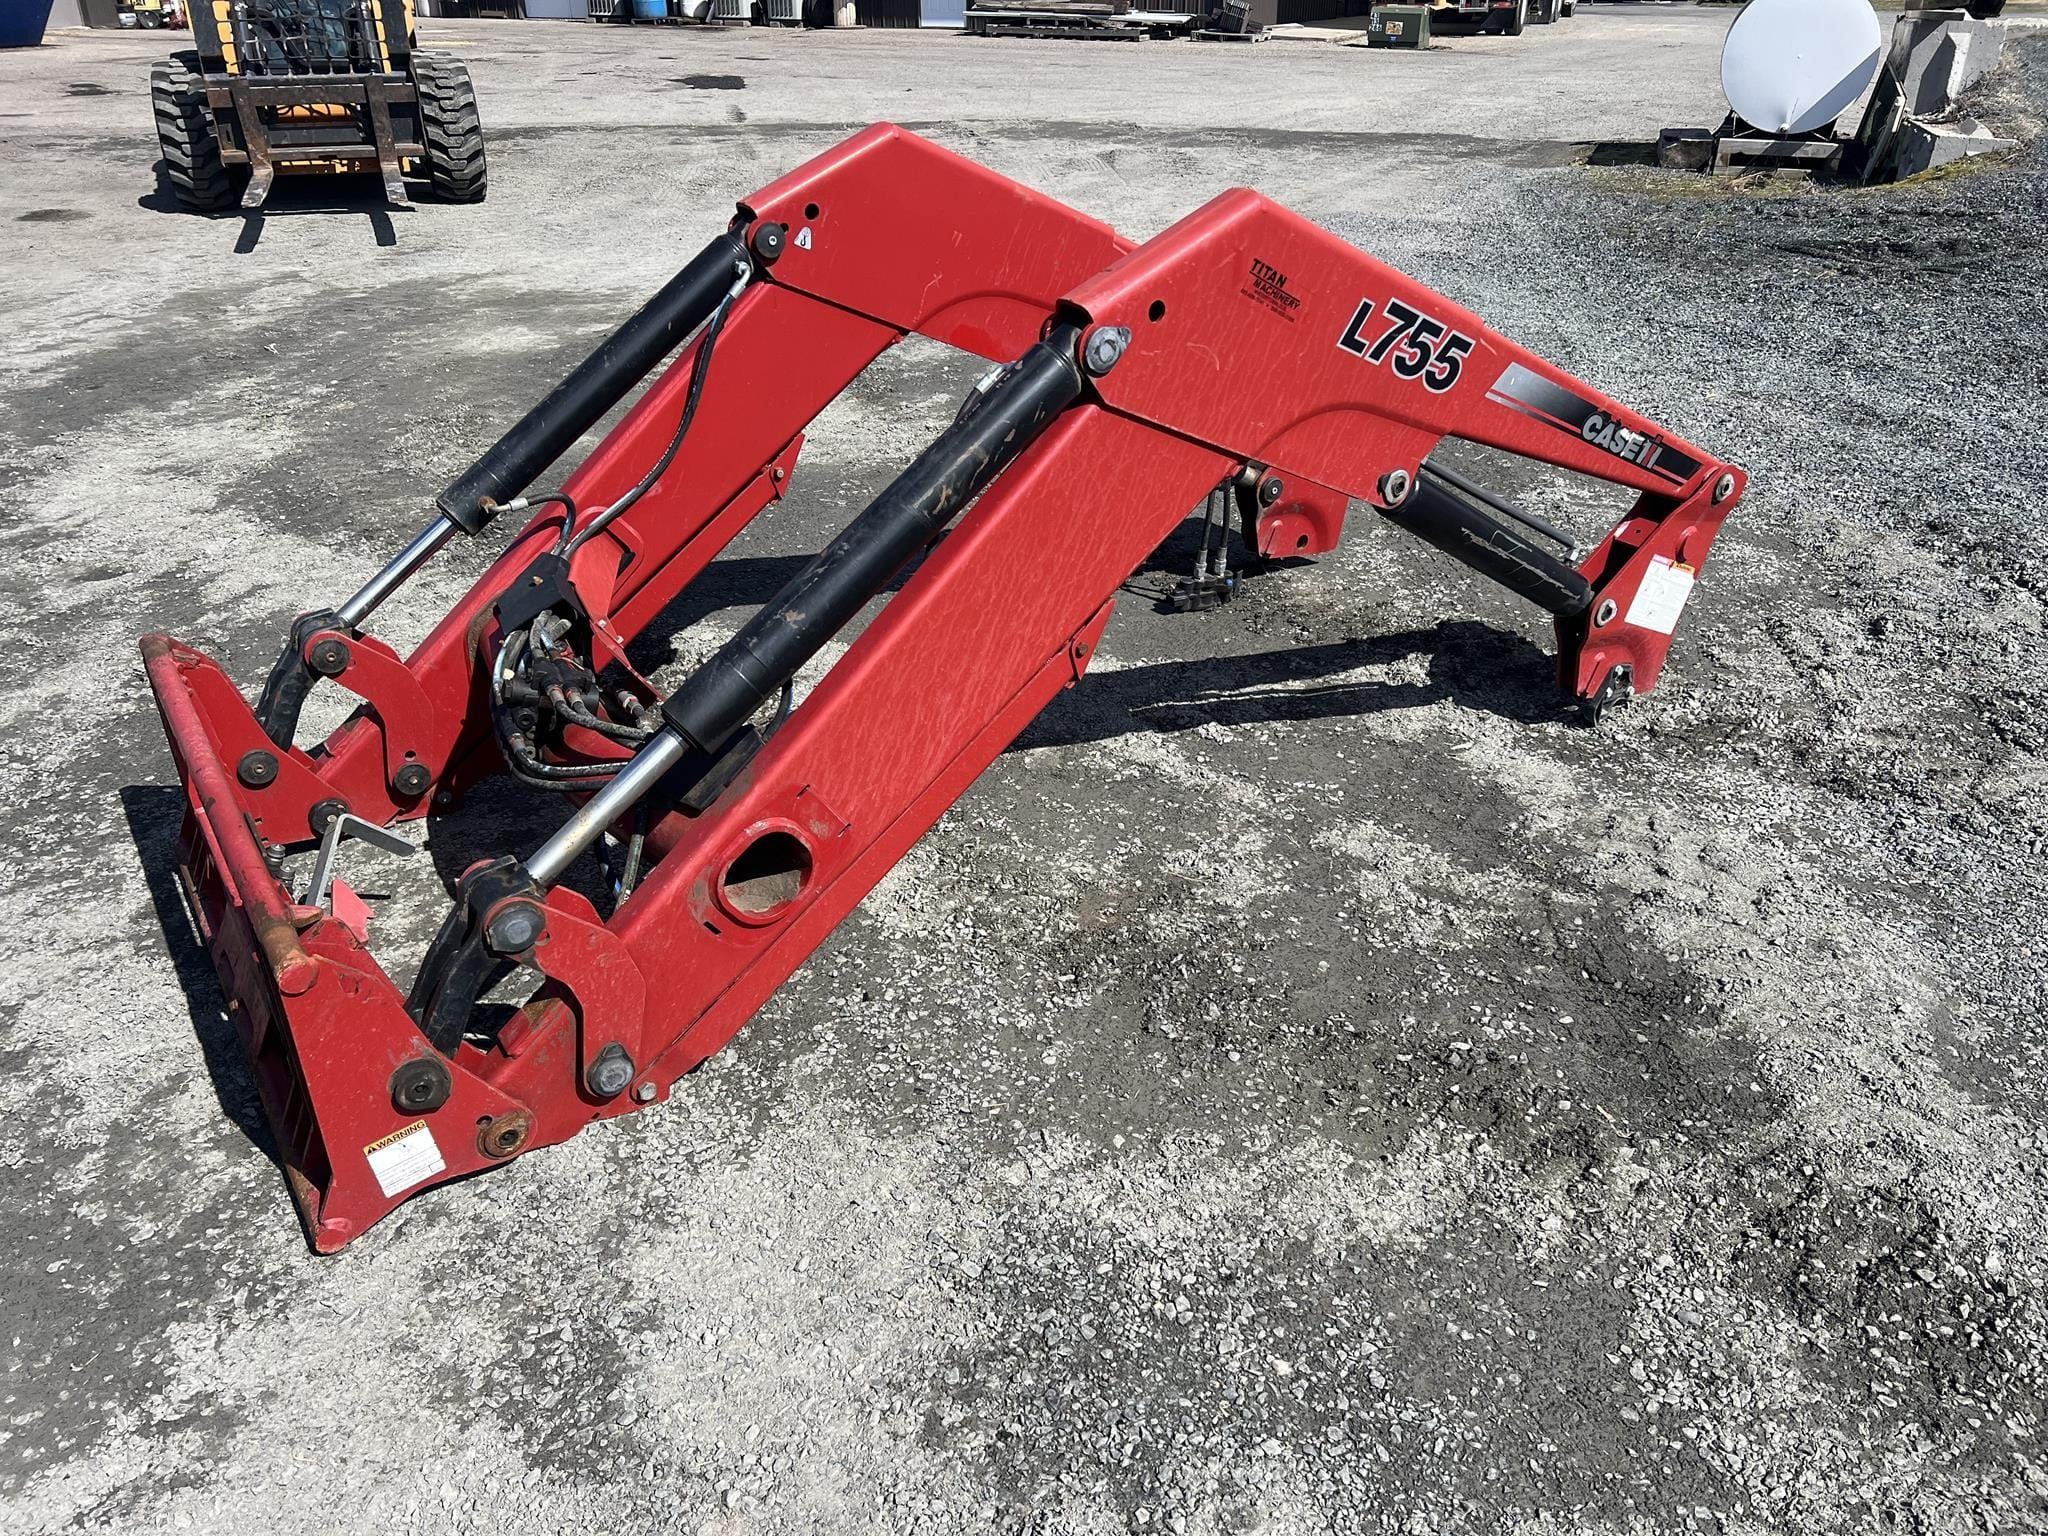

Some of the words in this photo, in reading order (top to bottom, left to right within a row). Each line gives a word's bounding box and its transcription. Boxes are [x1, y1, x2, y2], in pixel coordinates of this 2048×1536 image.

[1251, 258, 1288, 288] TITAN
[1253, 279, 1301, 310] MACHINERY
[1336, 297, 1476, 394] L755
[376, 1121, 425, 1149] WARNING
